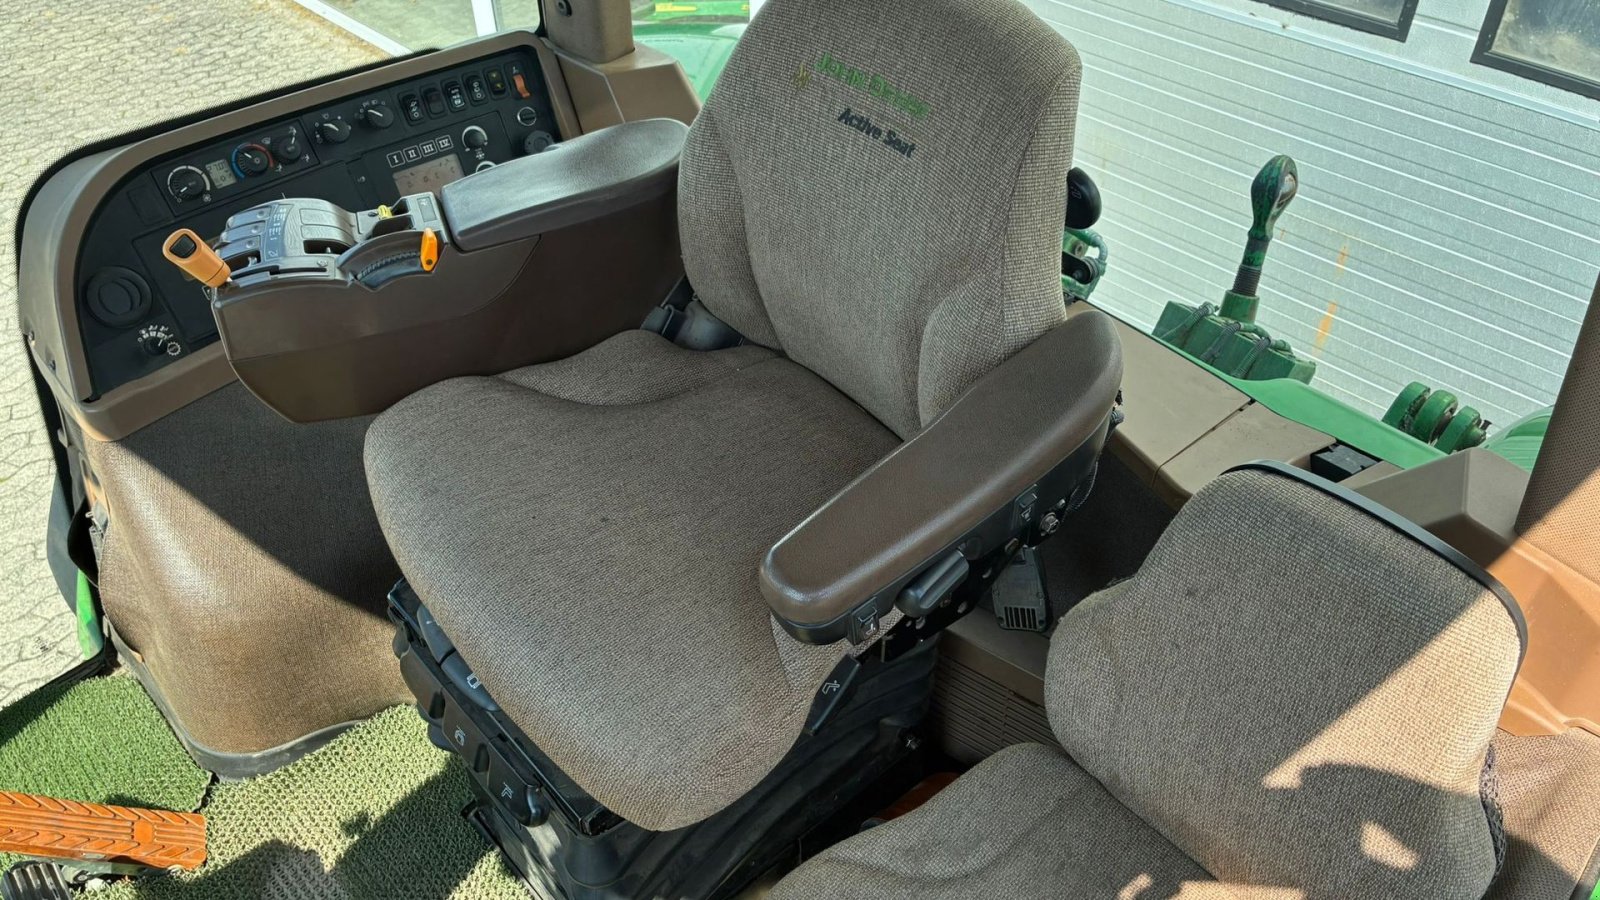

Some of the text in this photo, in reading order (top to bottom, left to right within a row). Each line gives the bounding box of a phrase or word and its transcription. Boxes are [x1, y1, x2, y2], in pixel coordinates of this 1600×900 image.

[423, 144, 434, 154] III
[439, 138, 451, 148] IV
[838, 107, 916, 158] Active Seat
